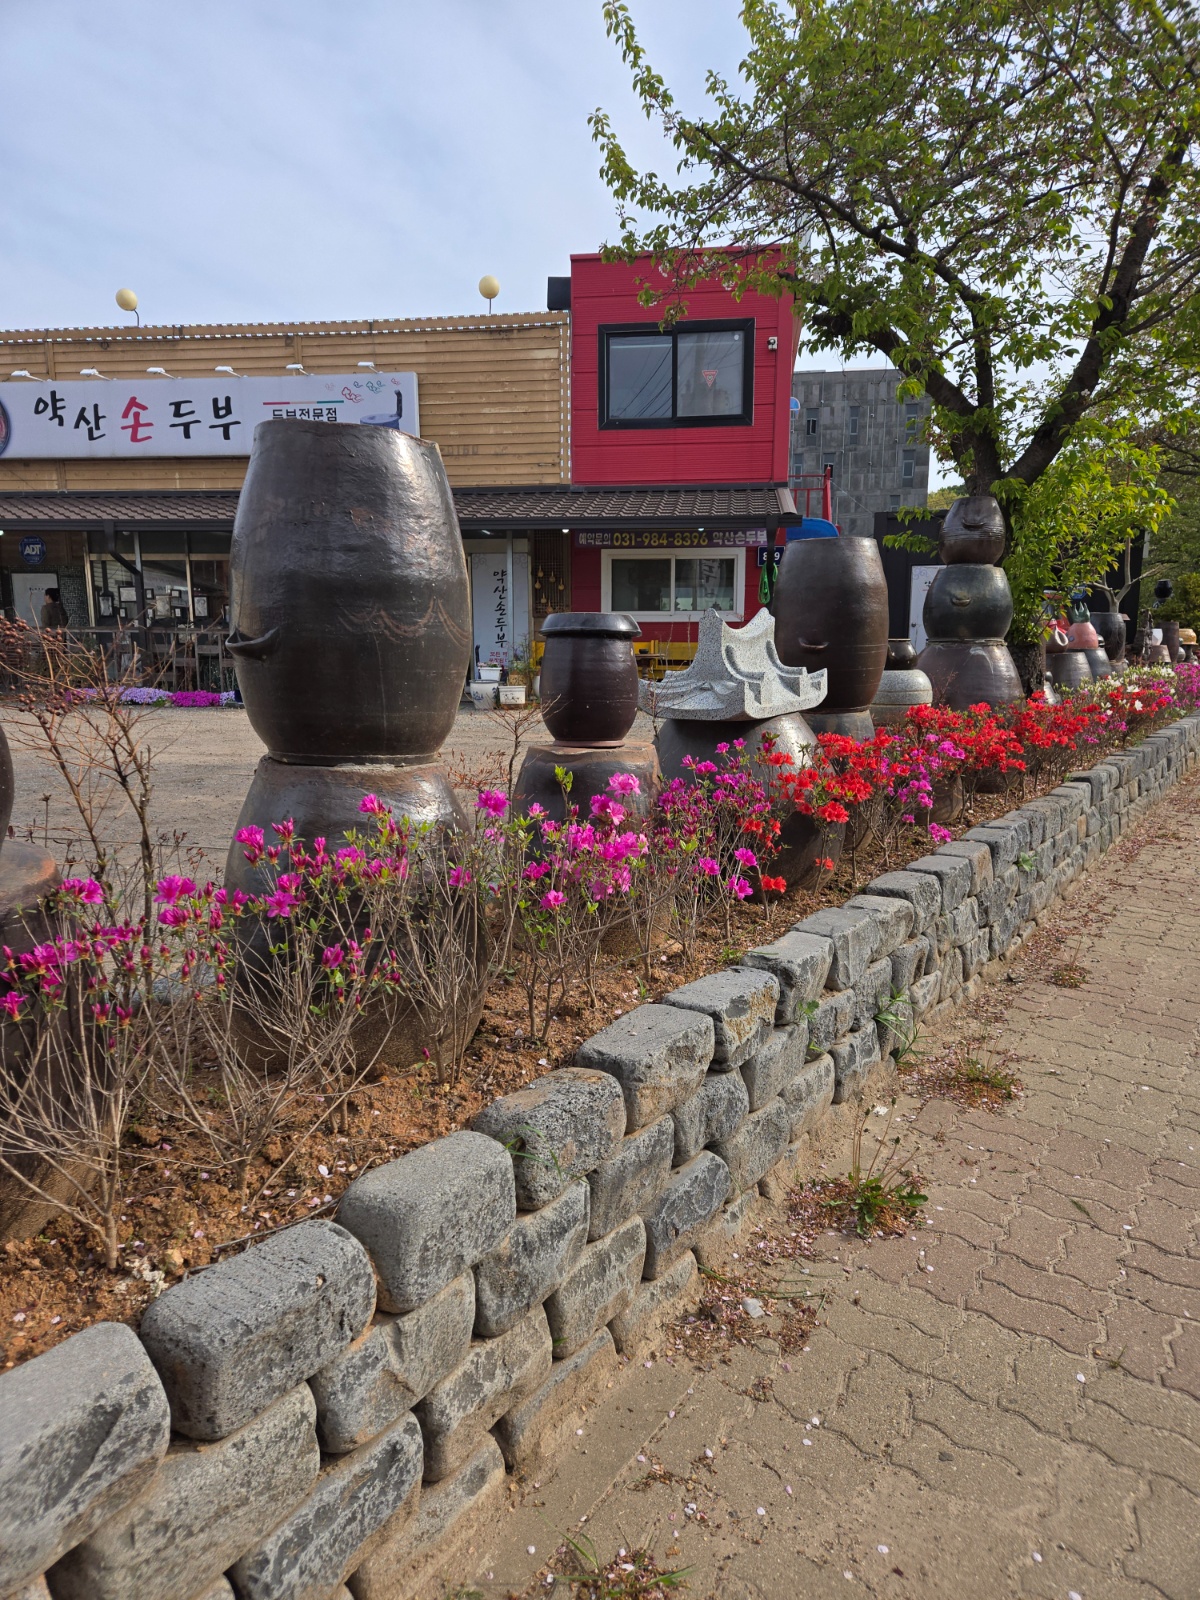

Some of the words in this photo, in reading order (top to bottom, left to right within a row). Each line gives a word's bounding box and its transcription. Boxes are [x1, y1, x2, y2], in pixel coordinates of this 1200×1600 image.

[613, 532, 708, 546] 031-984-8396
[712, 530, 767, 545] 약산손두부
[24, 544, 41, 555] ADT
[762, 551, 780, 561] 89
